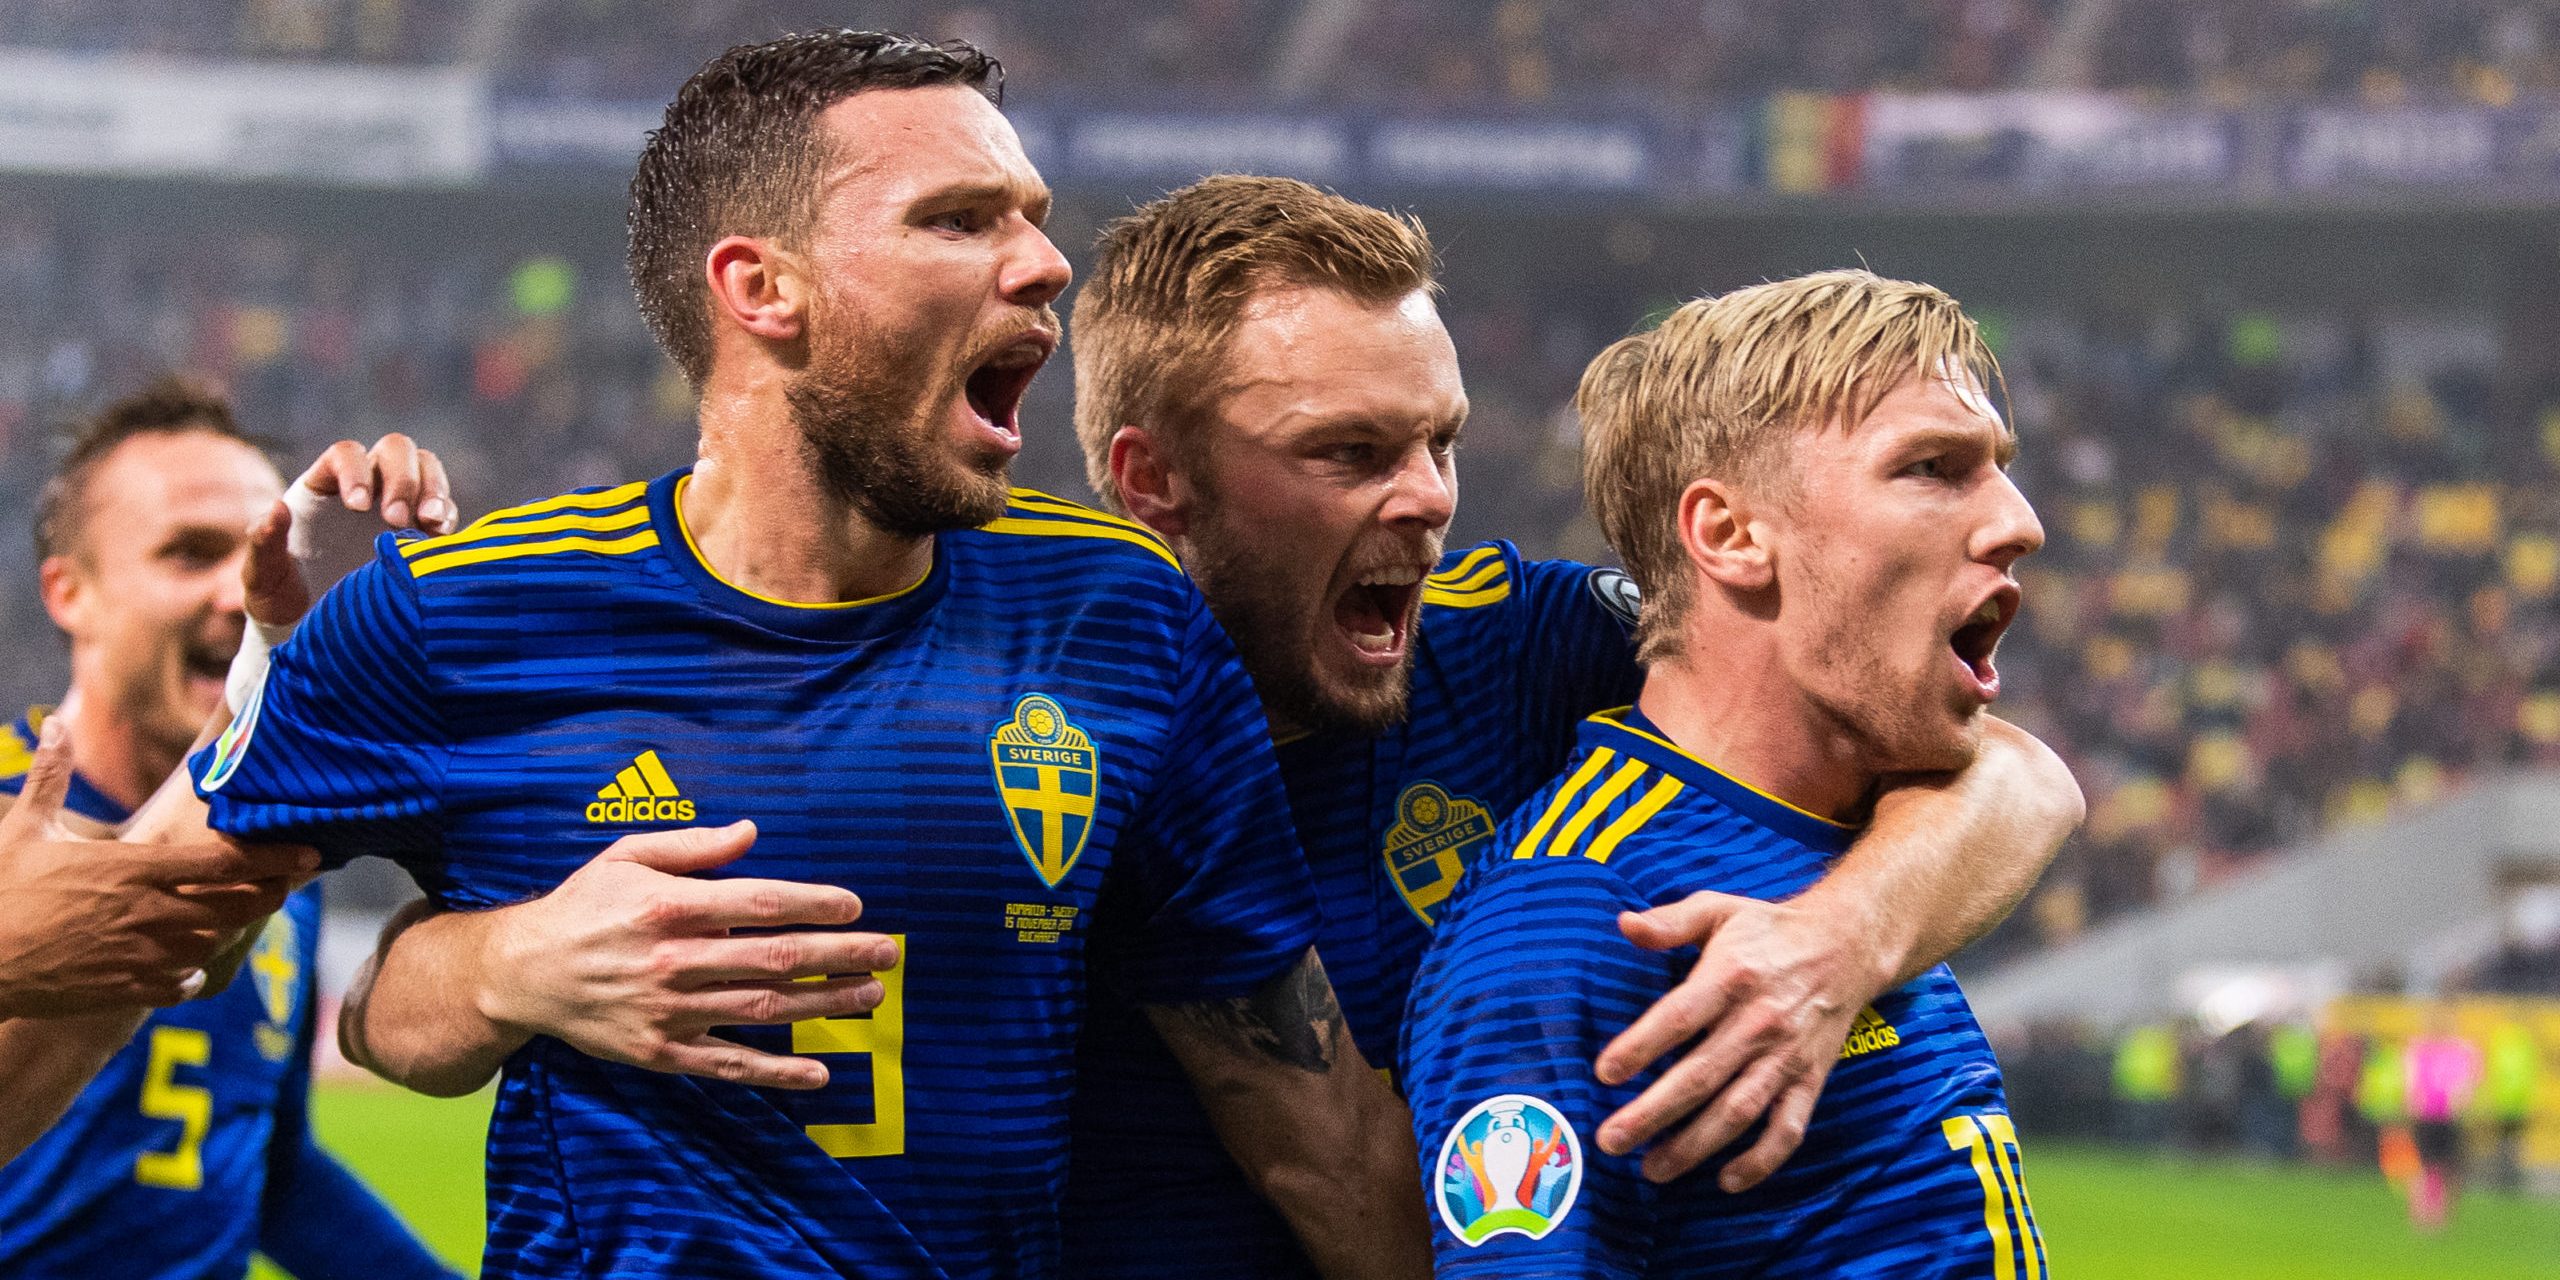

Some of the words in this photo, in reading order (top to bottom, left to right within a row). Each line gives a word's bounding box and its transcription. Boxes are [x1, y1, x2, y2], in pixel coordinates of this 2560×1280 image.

[1009, 748, 1082, 765] SVERIGE
[585, 795, 697, 823] adidas
[1402, 822, 1476, 861] SVERIGE
[1005, 916, 1014, 928] 15
[134, 1024, 212, 1190] 5
